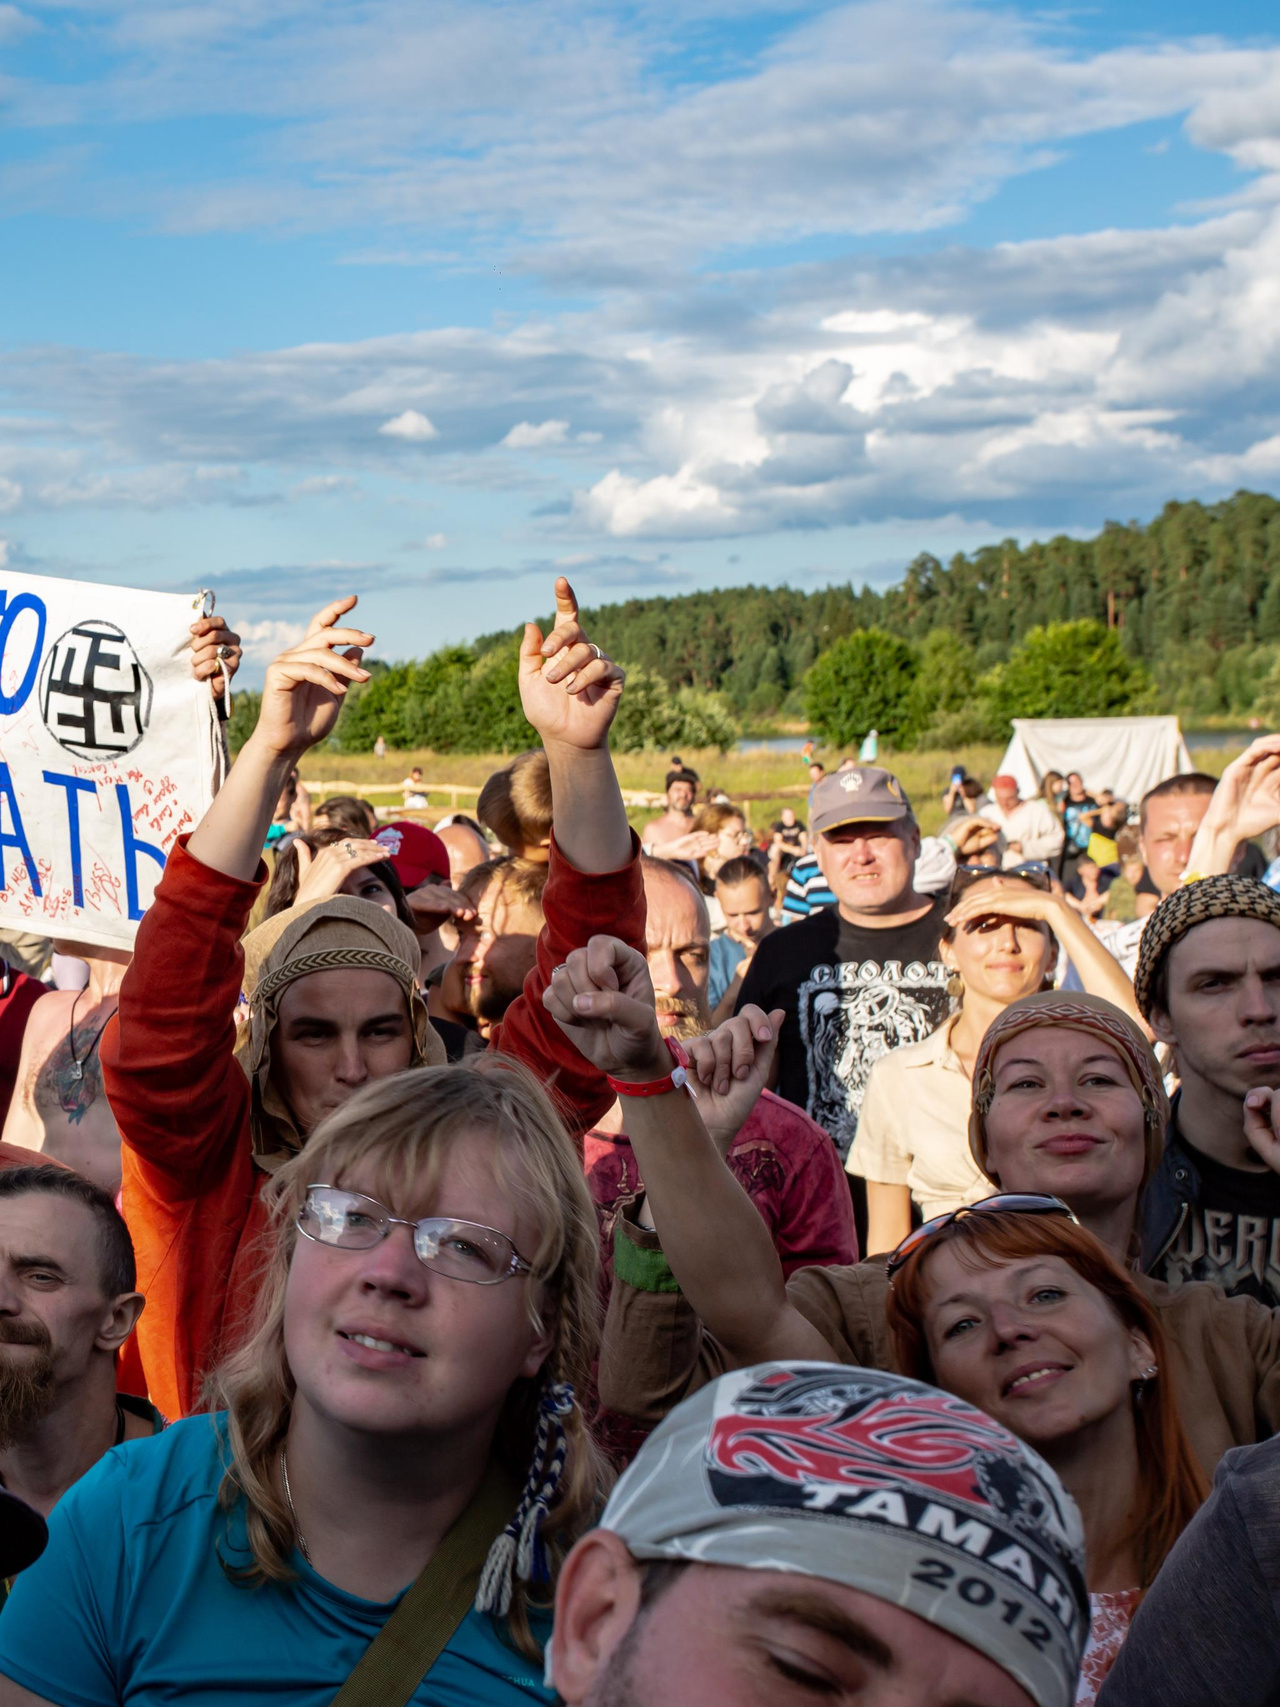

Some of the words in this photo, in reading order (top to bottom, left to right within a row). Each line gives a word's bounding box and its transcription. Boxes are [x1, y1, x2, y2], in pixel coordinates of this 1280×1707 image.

[810, 960, 949, 983] СКОЛОТ
[1167, 1208, 1280, 1287] WER
[912, 1557, 1052, 1652] 2012
